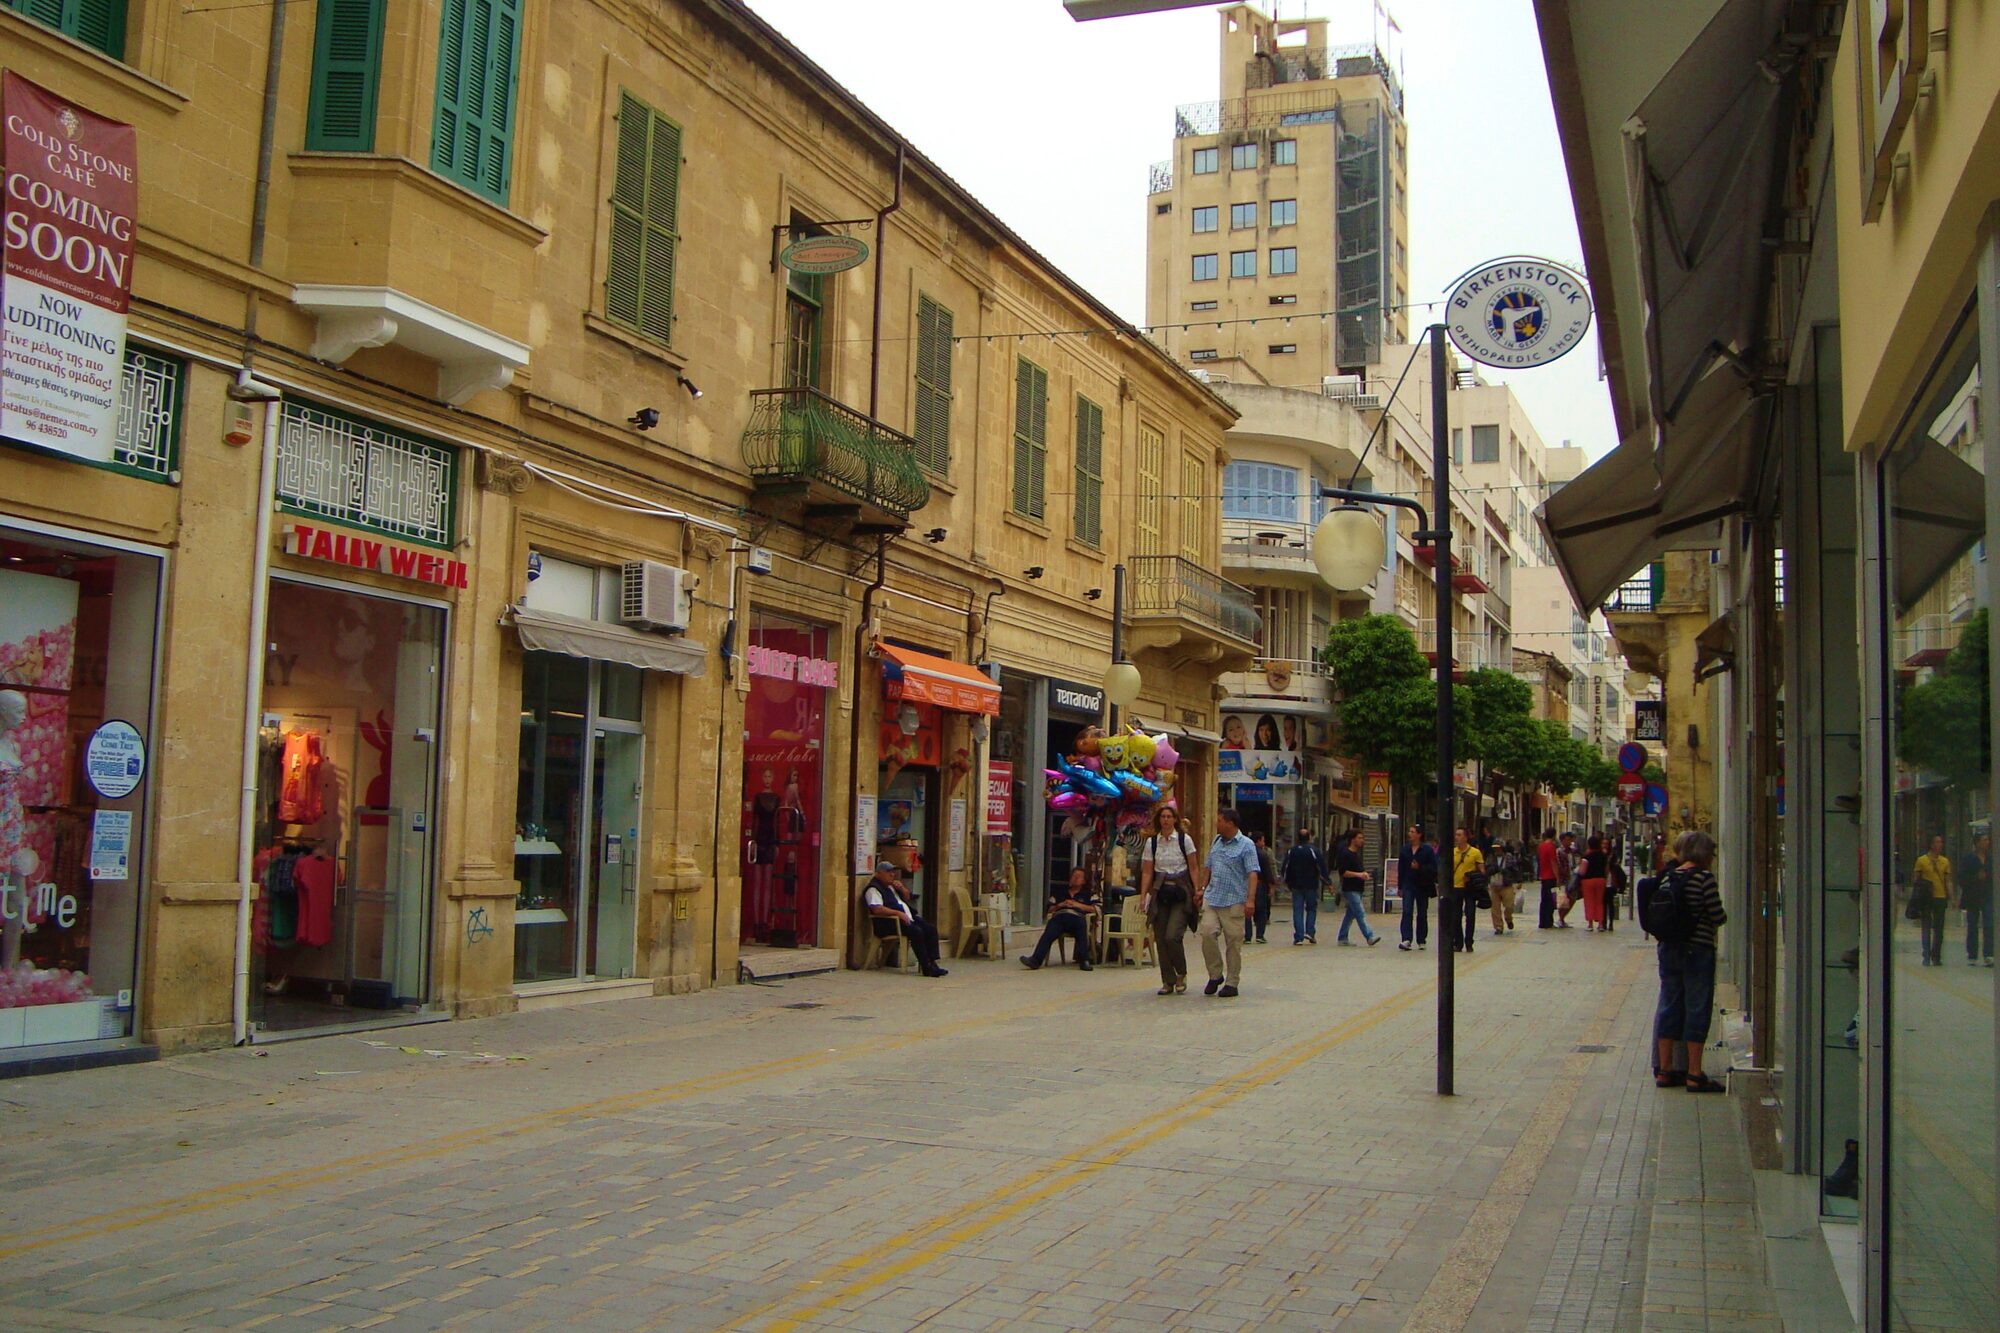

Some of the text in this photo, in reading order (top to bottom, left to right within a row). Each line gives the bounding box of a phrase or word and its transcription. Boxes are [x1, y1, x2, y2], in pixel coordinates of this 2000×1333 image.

[8, 114, 134, 184] COLD STONE
[47, 153, 97, 188] CAFÉ
[8, 173, 132, 242] COMING
[6, 211, 129, 289] SOON
[7, 260, 121, 309] ww.coldstonecreamery.com.cy
[1454, 266, 1582, 309] BIRKENSTOCK
[1489, 285, 1546, 307] BIRKENSTOCK
[39, 293, 82, 321] NOW
[3, 305, 116, 355] UDITIONING
[1455, 320, 1582, 363] ORTHOPAEDIC SHOES
[1487, 317, 1549, 349] MADE IN GERMANY
[26, 419, 37, 432] 96
[294, 524, 383, 570] TALLY
[748, 644, 838, 688] SWEET BABE
[1594, 675, 1603, 744] DEBENHA
[1637, 710, 1659, 720] PULL
[1642, 719, 1660, 729] AND
[1637, 728, 1660, 738] BEAR
[90, 761, 125, 778] FREE
[749, 746, 816, 762] sweet babe
[987, 780, 1010, 797] ECIAL
